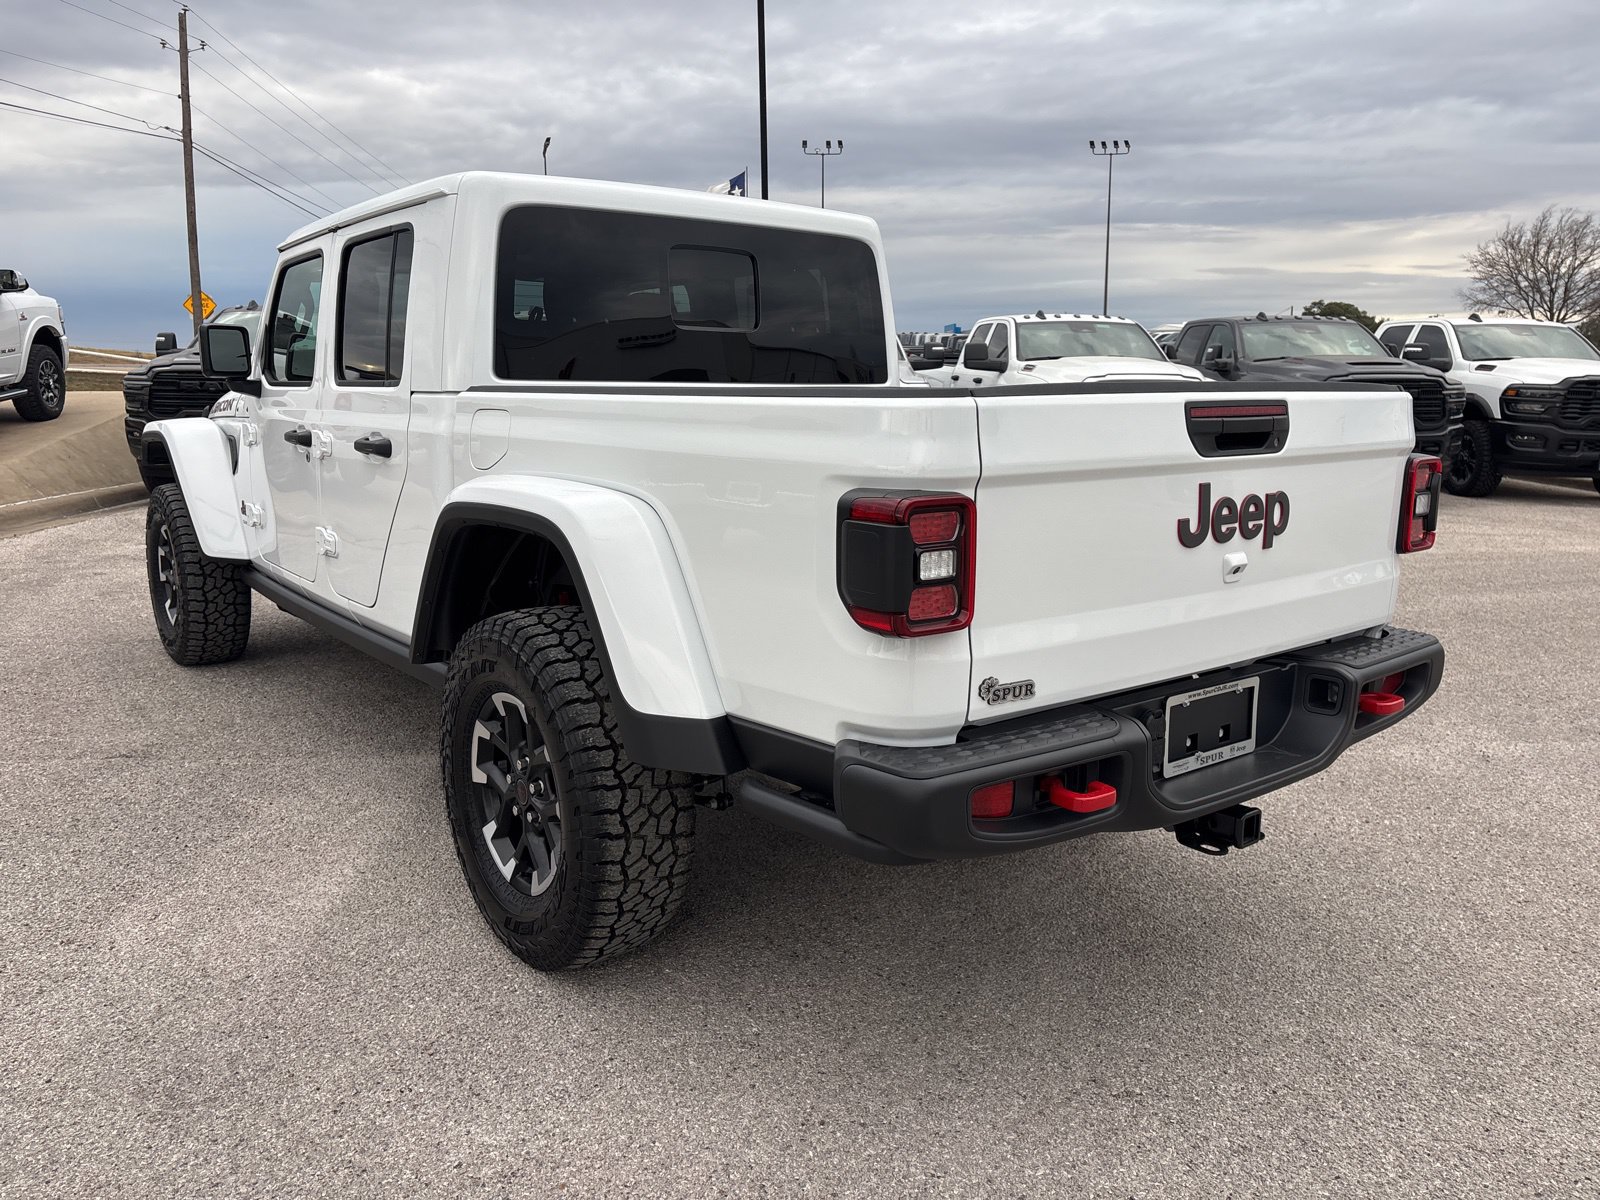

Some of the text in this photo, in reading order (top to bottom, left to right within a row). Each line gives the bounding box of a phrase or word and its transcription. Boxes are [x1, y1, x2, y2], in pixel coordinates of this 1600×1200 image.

[1177, 482, 1290, 550] Jeep
[992, 683, 1034, 702] SPUR
[1200, 751, 1224, 766] SPUR
